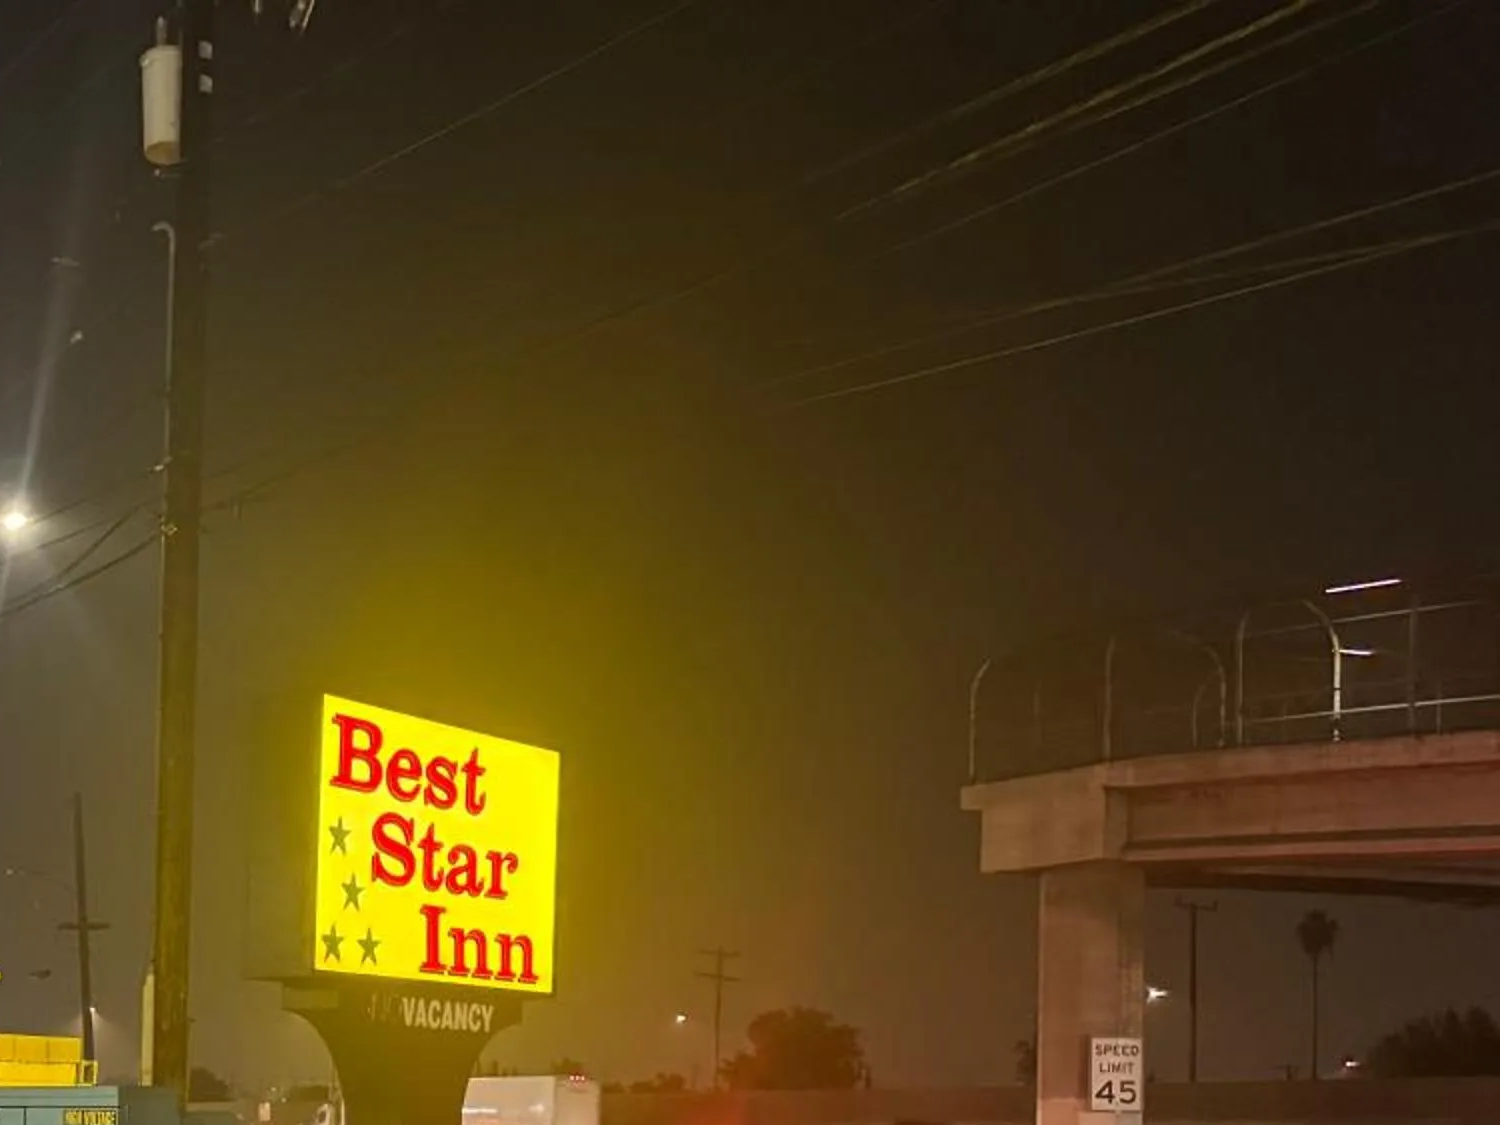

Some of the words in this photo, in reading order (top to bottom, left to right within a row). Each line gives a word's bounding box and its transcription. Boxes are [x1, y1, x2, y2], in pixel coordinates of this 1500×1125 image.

[330, 713, 486, 815] Best
[371, 812, 519, 900] Star
[418, 904, 539, 984] Inn
[402, 996, 494, 1033] VACANCY
[1095, 1043, 1139, 1057] SPEED
[1099, 1062, 1135, 1074] LIMIT
[1095, 1080, 1137, 1105] 45
